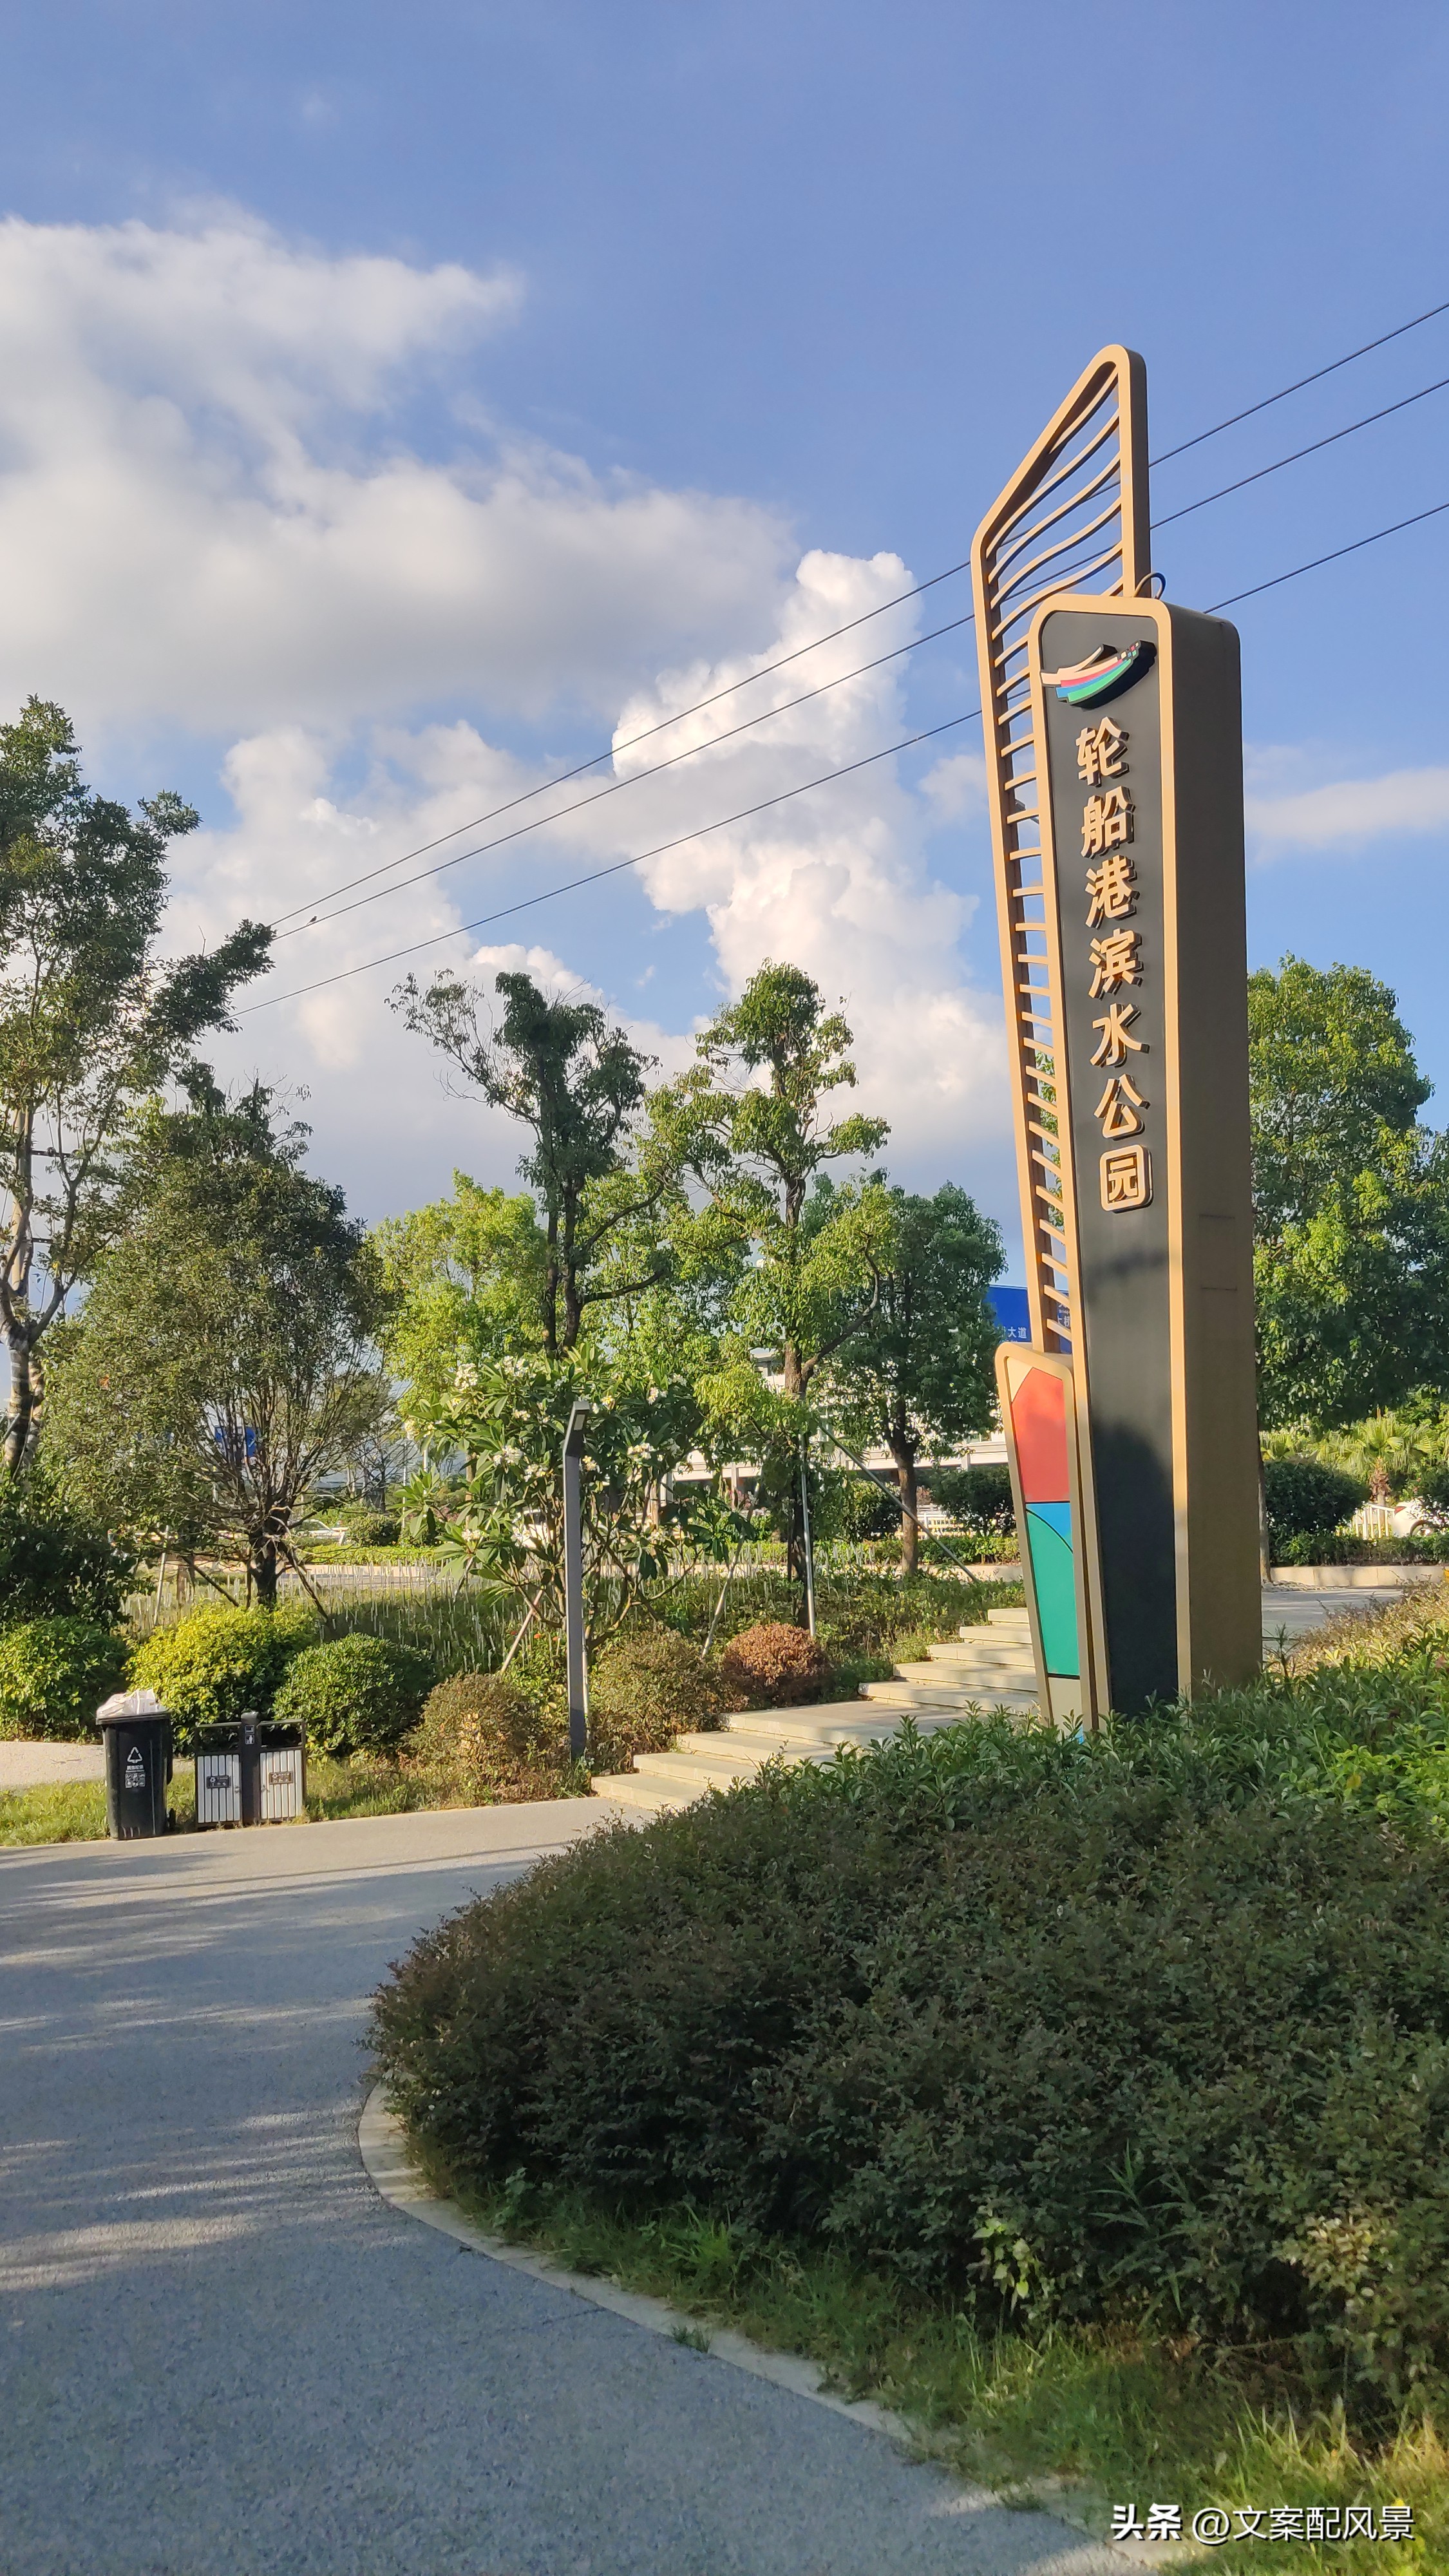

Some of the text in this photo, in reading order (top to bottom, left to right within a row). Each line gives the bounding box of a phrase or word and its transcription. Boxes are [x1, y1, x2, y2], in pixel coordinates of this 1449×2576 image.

[1075, 715, 1149, 1212] 轮船港滨水公园
